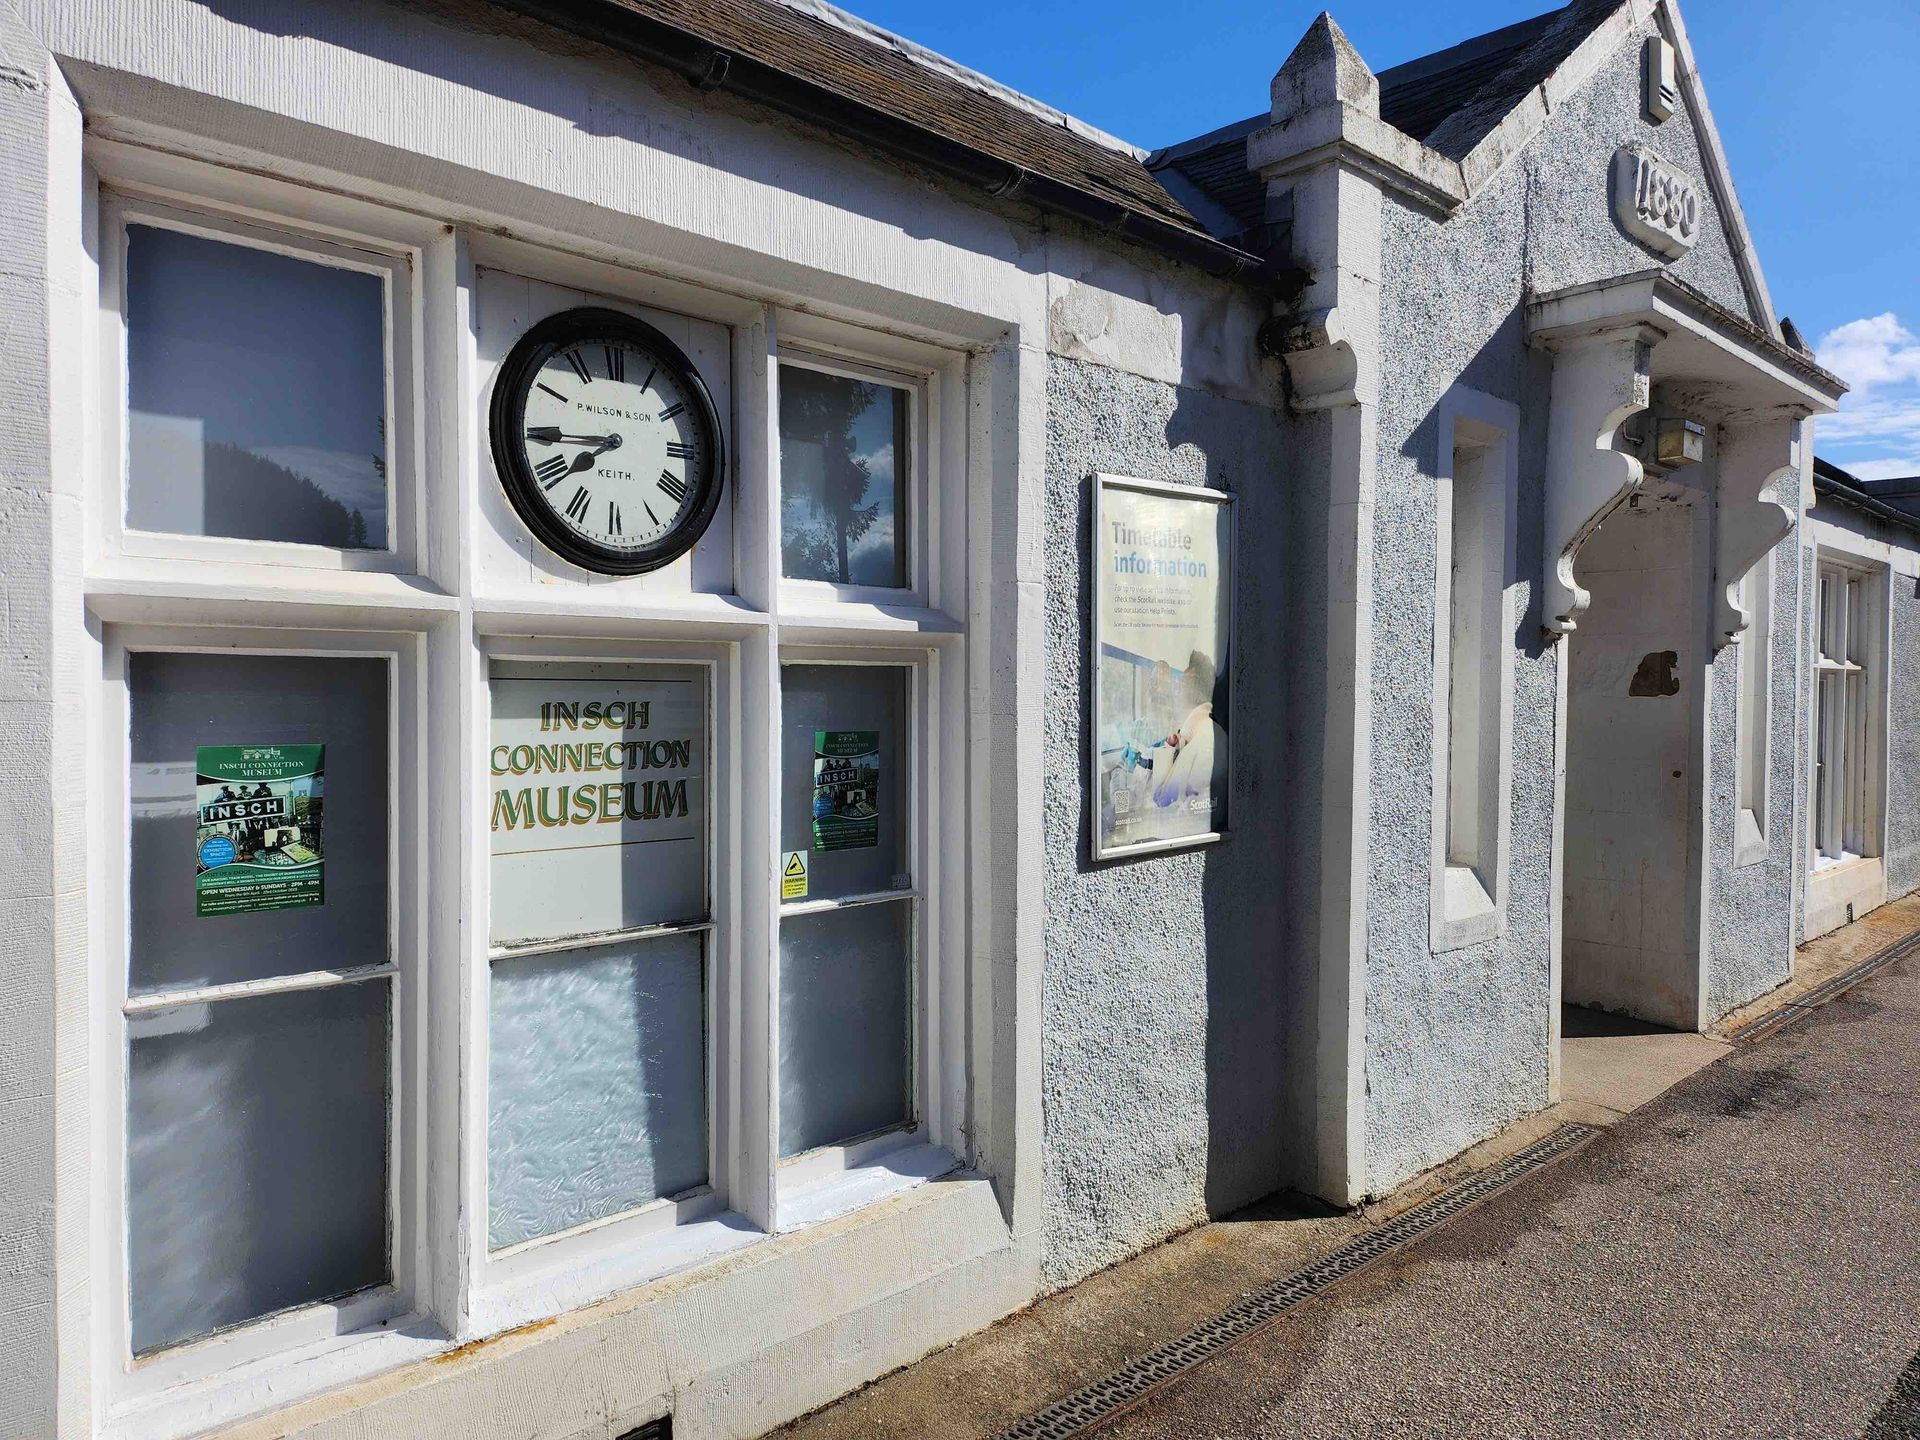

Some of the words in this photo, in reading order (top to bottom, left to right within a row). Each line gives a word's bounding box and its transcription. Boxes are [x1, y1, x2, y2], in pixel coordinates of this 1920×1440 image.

[1635, 157, 1697, 239] 1880
[624, 411, 631, 419] &
[598, 469, 635, 481] KEITH.
[1112, 521, 1192, 550] Timetable
[1114, 549, 1208, 578] information
[540, 701, 651, 732] INSCH
[219, 762, 247, 770] INSCH
[248, 761, 304, 769] CONNECTION
[490, 739, 691, 776] CONNECTION
[242, 768, 282, 777] MUSEUM
[819, 770, 855, 784] INSCH
[209, 800, 278, 820] INSCH
[490, 779, 690, 832] MUSEUM
[219, 885, 255, 893] WEDNESDAY
